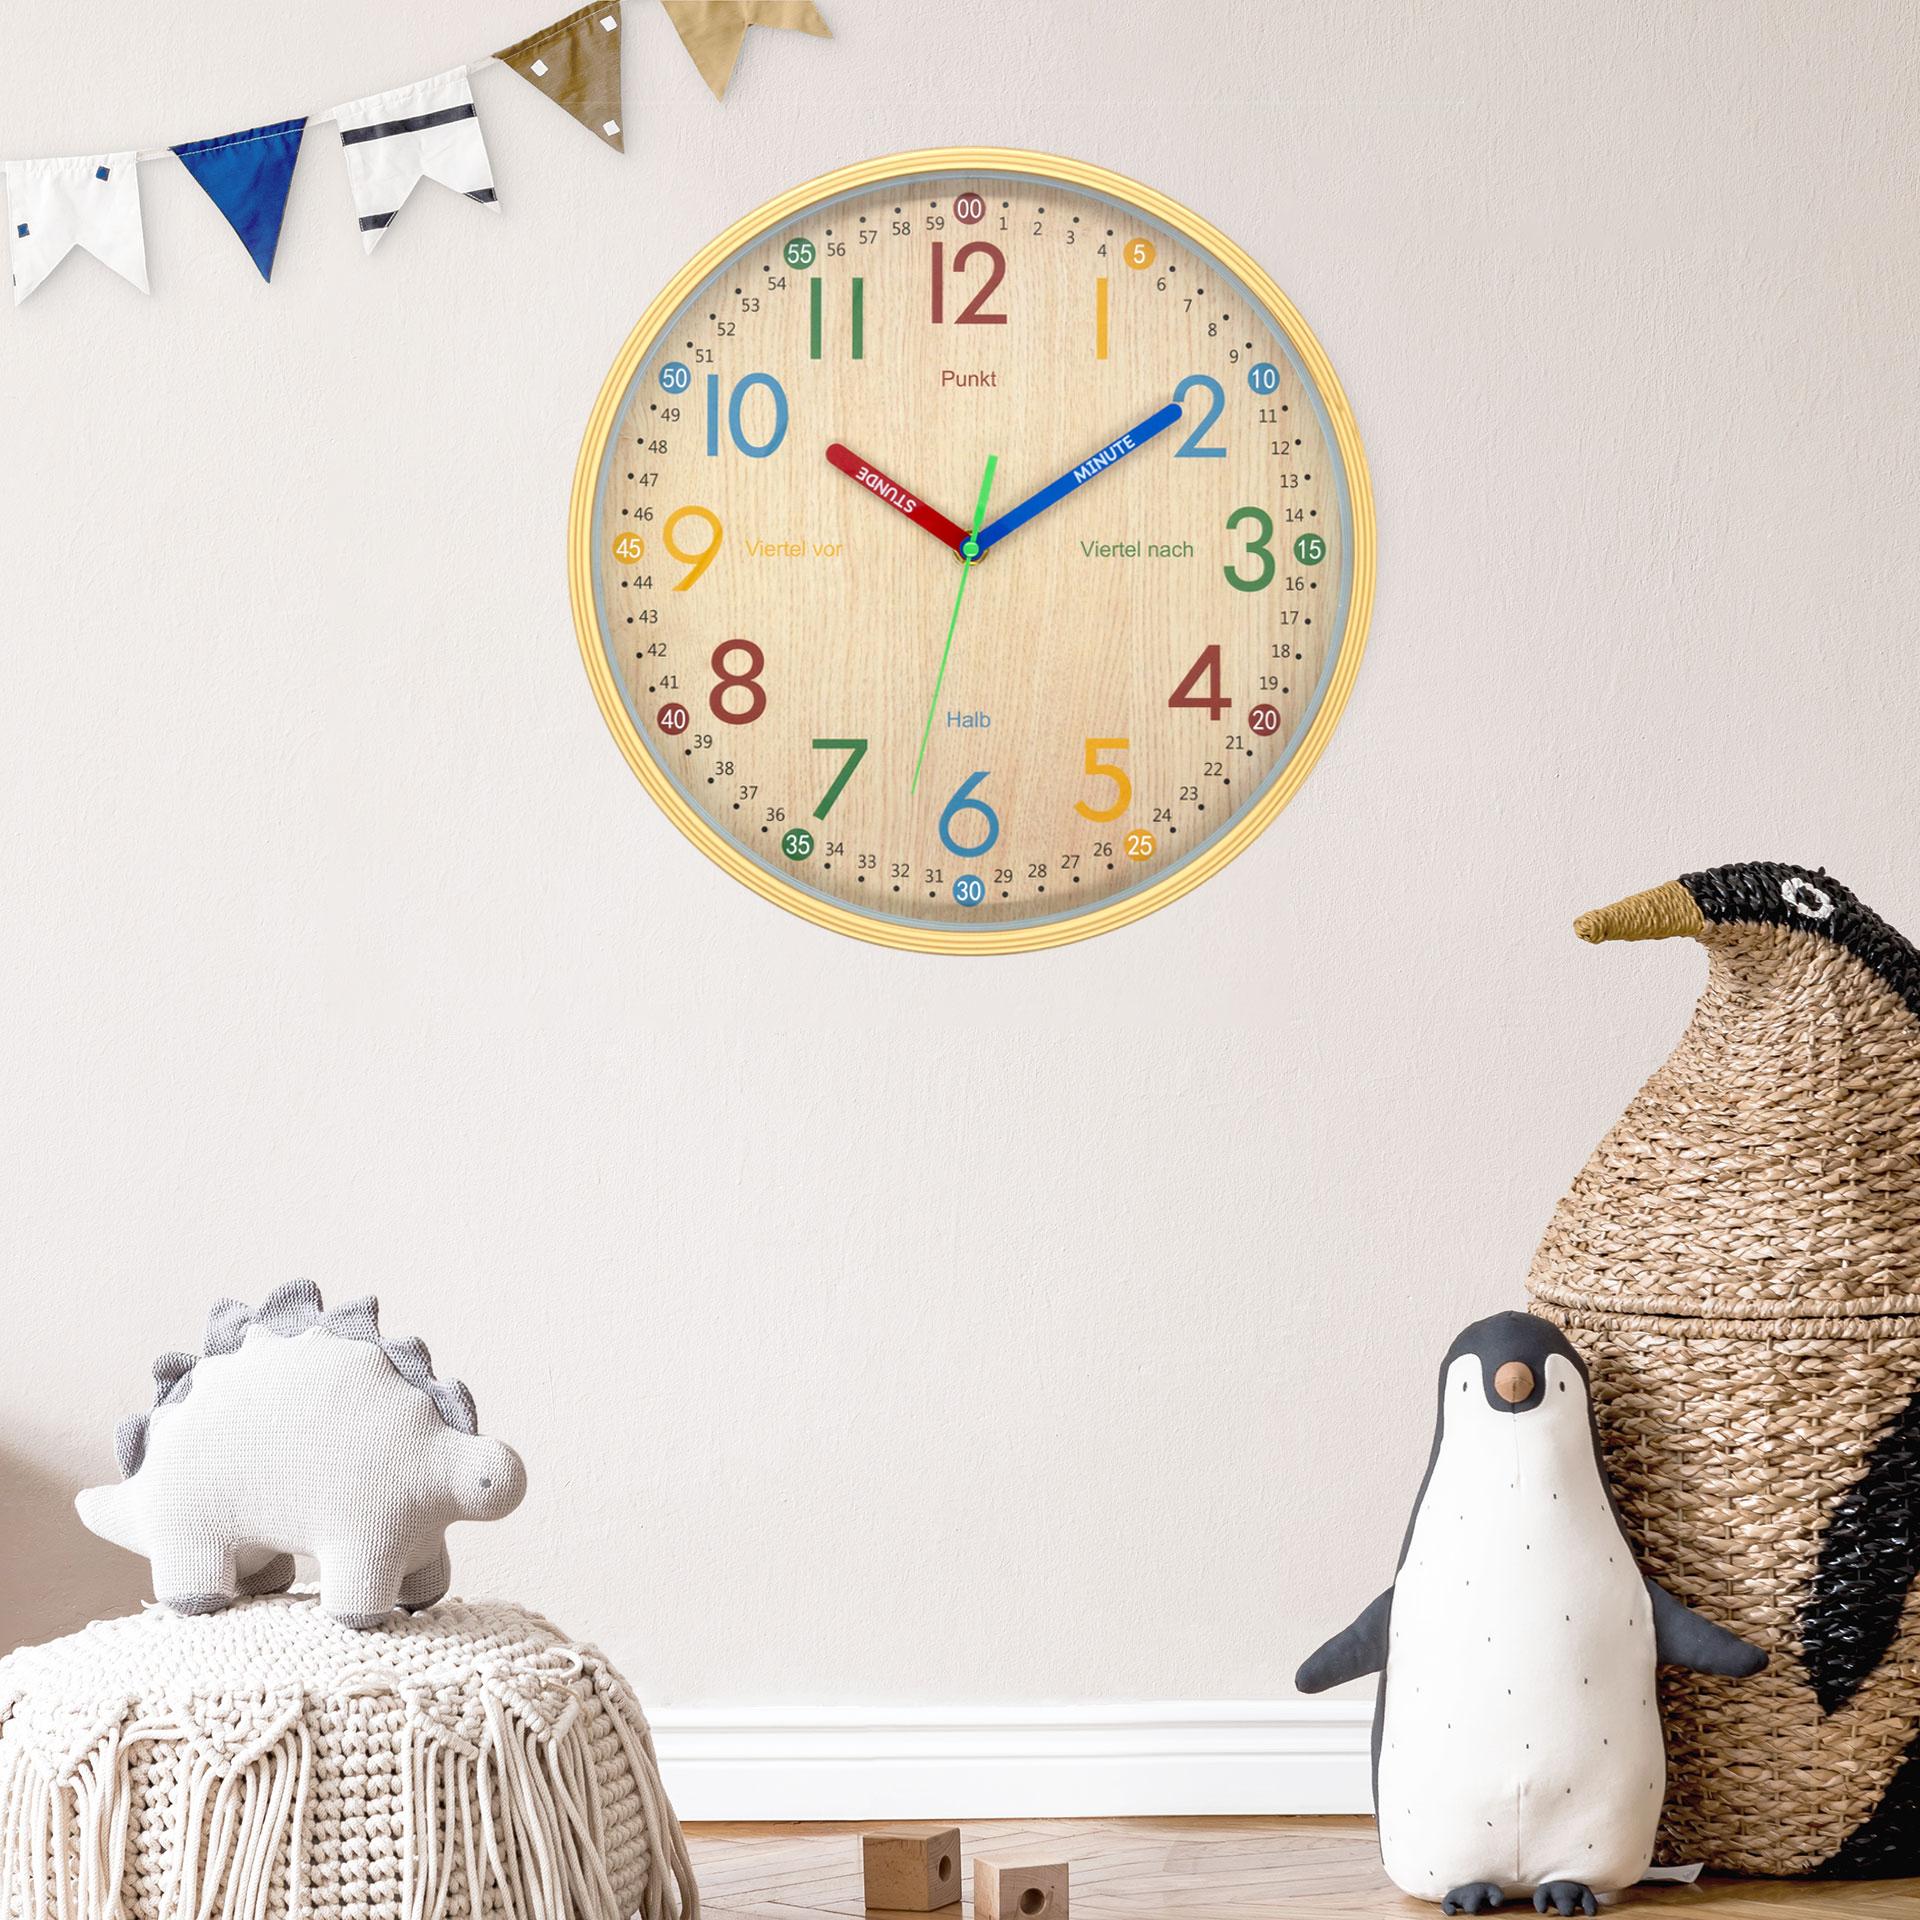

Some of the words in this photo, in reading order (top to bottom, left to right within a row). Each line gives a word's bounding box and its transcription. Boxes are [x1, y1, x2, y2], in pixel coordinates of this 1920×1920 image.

[957, 199, 982, 218] 00
[892, 222, 910, 236] 58
[926, 216, 944, 231] 59
[1000, 217, 1008, 231] 1
[1033, 222, 1041, 236] 2
[859, 231, 877, 245] 57
[1067, 231, 1075, 244] 3
[788, 244, 812, 263] 55
[827, 242, 845, 256] 56
[1097, 244, 1107, 257] 4
[1133, 245, 1145, 264] 5
[768, 277, 786, 291] 54
[932, 241, 1007, 324] 12
[1157, 277, 1166, 291] 6
[741, 298, 760, 312] 53
[1183, 299, 1192, 313] 7
[810, 277, 863, 359] 11
[1096, 278, 1108, 359] 1
[717, 322, 736, 337] 52
[1208, 323, 1217, 337] 8
[696, 349, 713, 363] 51
[1229, 349, 1238, 363] 9
[663, 369, 687, 388] 50
[942, 370, 997, 387] Punkt
[1252, 370, 1276, 388] 10
[661, 408, 680, 422] 49
[707, 372, 788, 458] 10
[1173, 374, 1226, 458] 2
[1259, 409, 1277, 423] 11
[649, 440, 667, 454] 48
[1271, 441, 1289, 455] 12
[1073, 434, 1136, 484] MINUTE
[640, 473, 658, 487] 47
[1280, 474, 1298, 488] 13
[855, 466, 917, 513] STUNDE
[634, 507, 653, 521] 46
[1286, 508, 1304, 522] 14
[616, 539, 641, 558] 45
[664, 506, 723, 591] 9
[745, 540, 805, 557] Viertel
[813, 543, 843, 557] vor
[1080, 540, 1140, 557] Viertel
[1148, 541, 1194, 557] nach
[1224, 506, 1275, 592] 3
[1298, 540, 1321, 559] 15
[633, 576, 653, 589] 44
[1286, 577, 1304, 591] 16
[639, 610, 658, 624] 43
[1280, 611, 1298, 625] 17
[647, 643, 667, 657] 42
[1272, 644, 1290, 658] 18
[659, 676, 678, 689] 41
[709, 639, 766, 725] 8
[1168, 645, 1232, 721] 4
[1260, 676, 1278, 690] 19
[661, 709, 686, 729] 40
[947, 712, 991, 729] Halb
[1252, 711, 1277, 729] 20
[694, 735, 712, 749] 39
[1225, 736, 1243, 750] 21
[715, 761, 734, 775] 38
[1204, 762, 1222, 776] 22
[812, 739, 868, 821] 7
[1073, 738, 1132, 823] 5
[739, 786, 758, 800] 37
[1180, 787, 1198, 801] 23
[766, 807, 785, 822] 36
[939, 772, 999, 857] 6
[1153, 808, 1172, 822] 24
[786, 835, 810, 854] 35
[825, 842, 844, 856] 34
[1094, 843, 1112, 857] 26
[1128, 836, 1152, 855] 25
[858, 855, 876, 869] 33
[1061, 855, 1079, 869] 27
[891, 864, 909, 878] 32
[925, 869, 943, 884] 31
[994, 869, 1012, 884] 29
[1028, 864, 1047, 878] 28
[957, 880, 982, 900] 30
